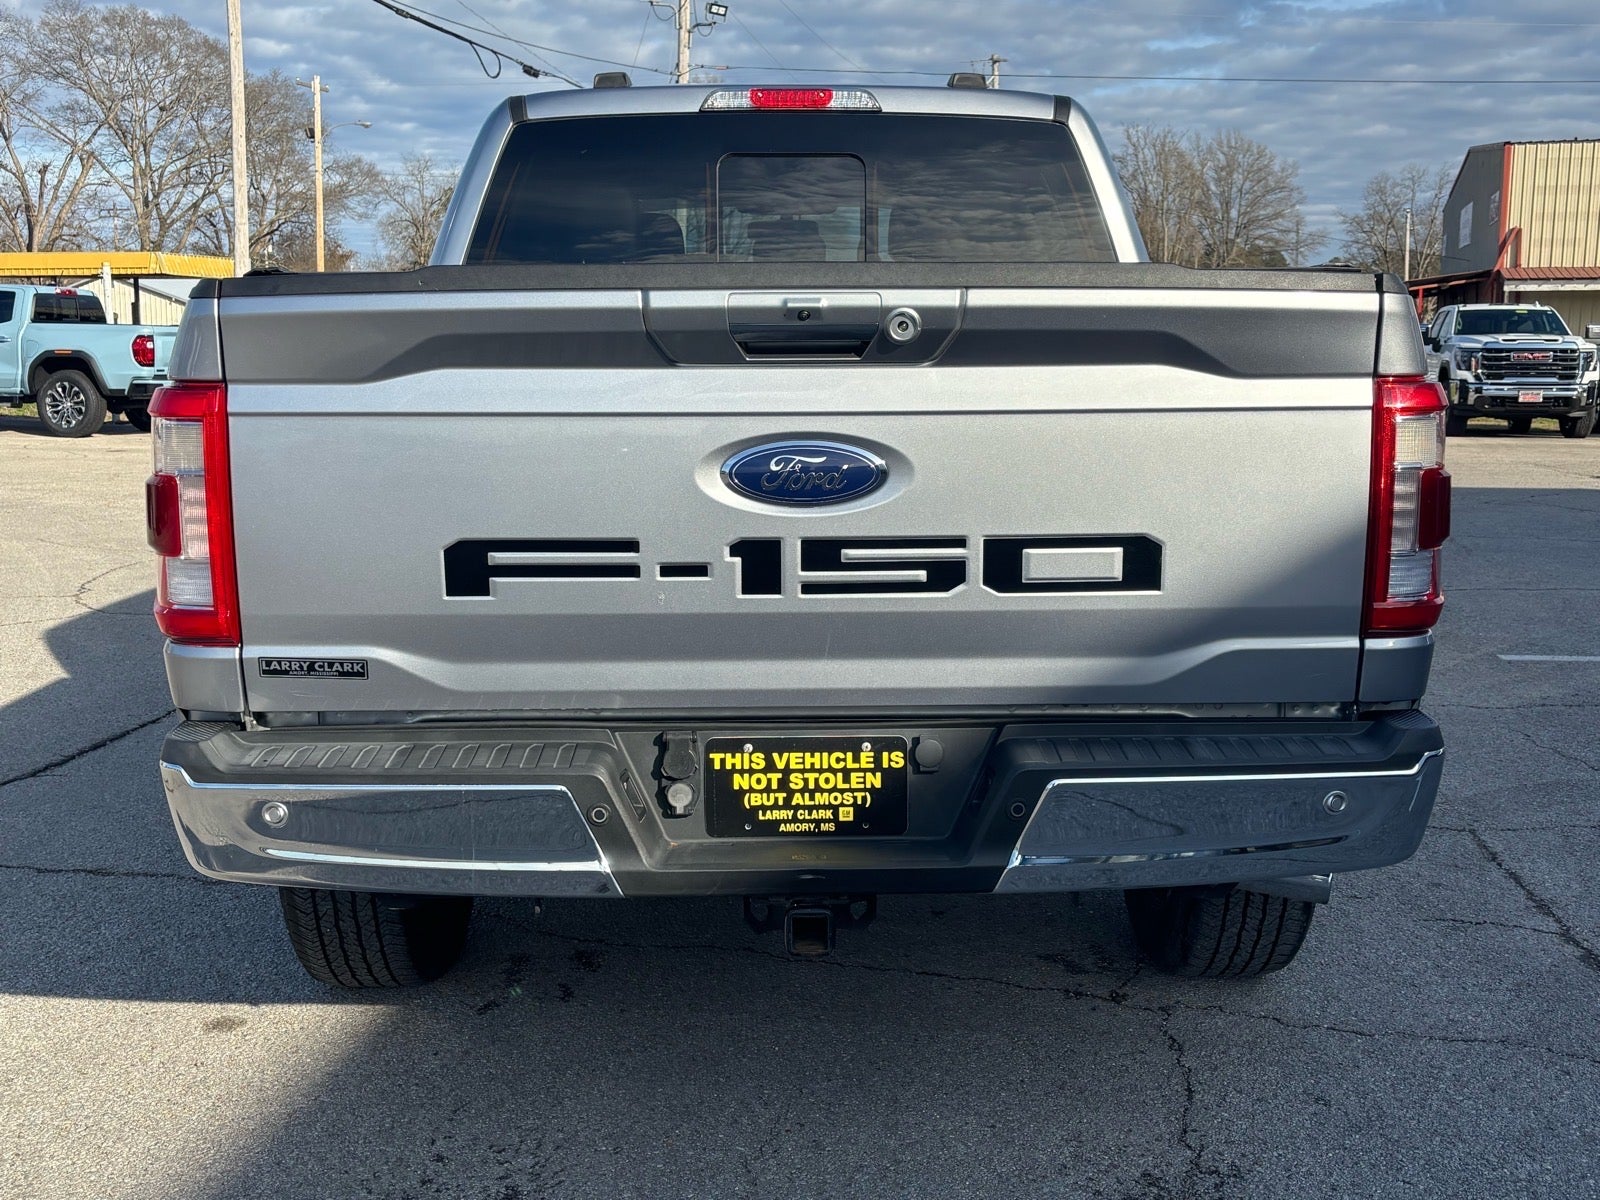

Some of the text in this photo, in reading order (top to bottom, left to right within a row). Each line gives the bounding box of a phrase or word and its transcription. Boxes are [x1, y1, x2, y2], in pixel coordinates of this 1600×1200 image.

[760, 454, 849, 491] Ford
[441, 534, 1165, 599] F-150
[262, 660, 364, 672] LARRY CLARK
[709, 751, 905, 770] THIS VEHICLE IS
[733, 772, 882, 790] NOT STOLEN
[743, 792, 871, 809] (BUT ALMOST)
[758, 809, 794, 820] LARRY
[797, 809, 833, 820] CLARK
[779, 822, 836, 833] AMORY, MS
